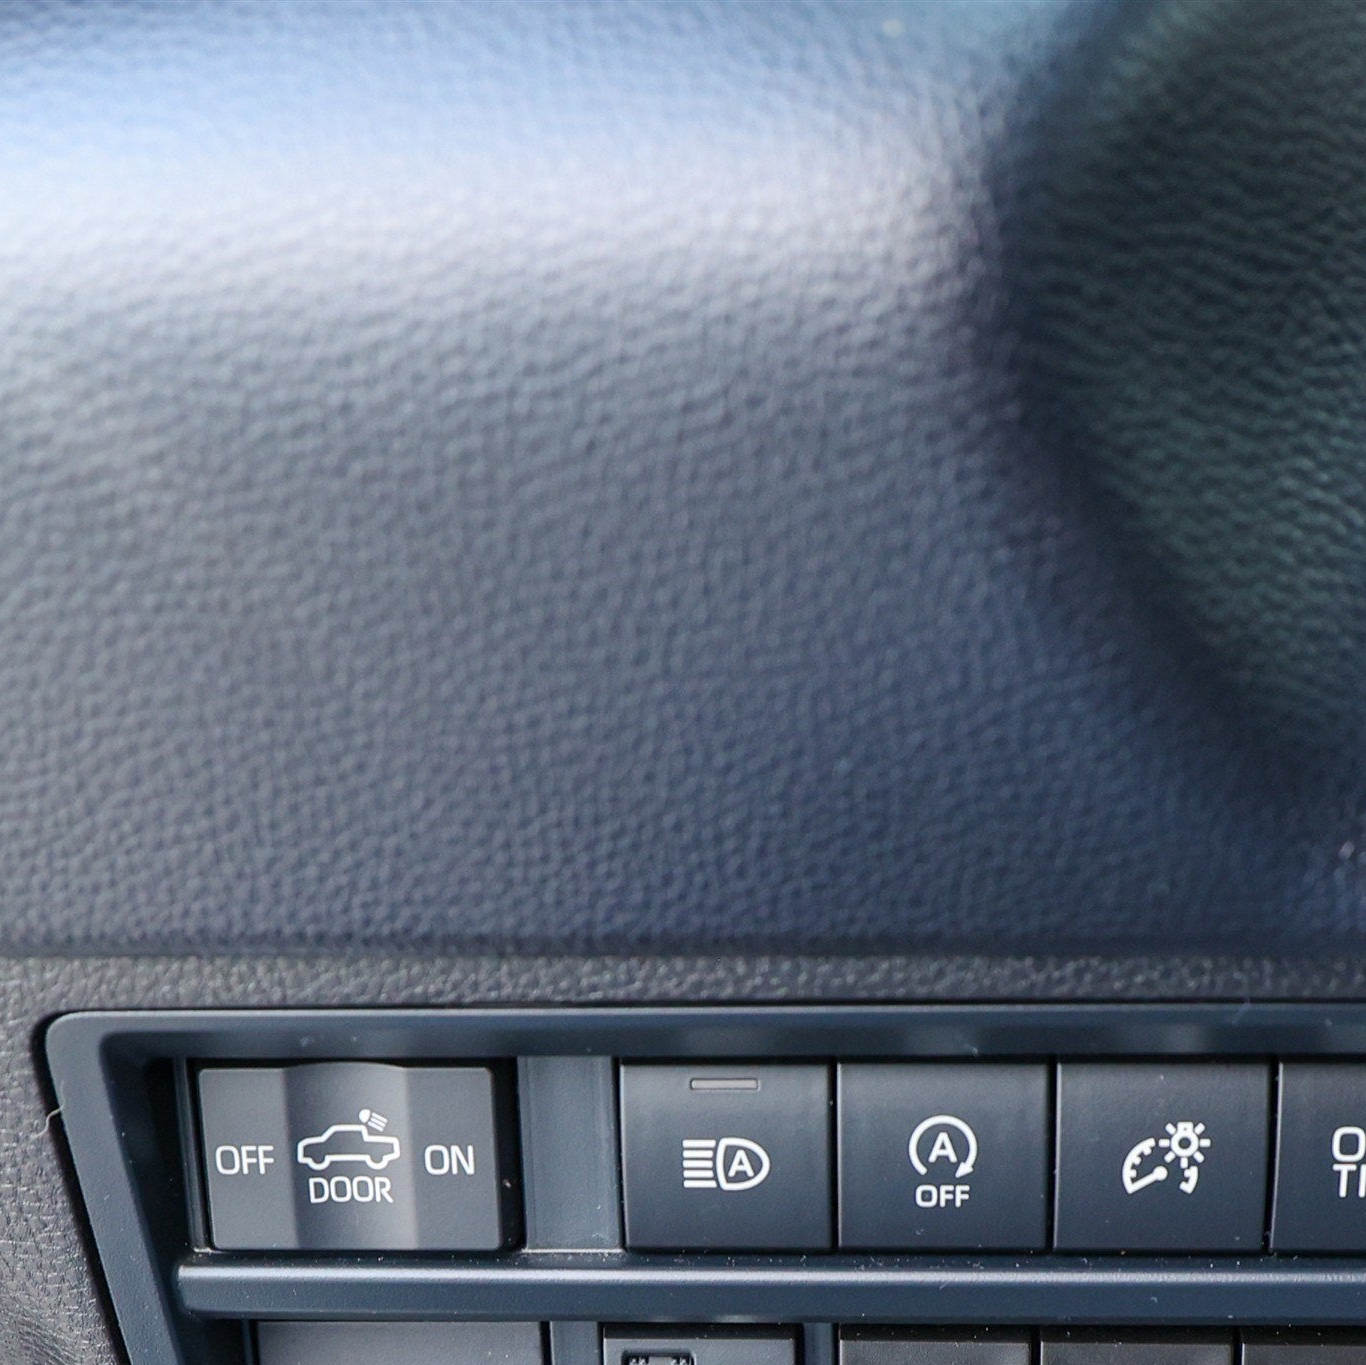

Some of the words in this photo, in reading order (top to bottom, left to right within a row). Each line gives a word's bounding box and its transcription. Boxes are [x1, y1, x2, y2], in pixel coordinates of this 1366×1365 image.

[215, 1145, 275, 1175] OFF
[424, 1144, 475, 1175] ON
[727, 1148, 755, 1177] A
[926, 1133, 958, 1164] A
[308, 1175, 393, 1204] DOOR
[915, 1184, 970, 1208] OFF
